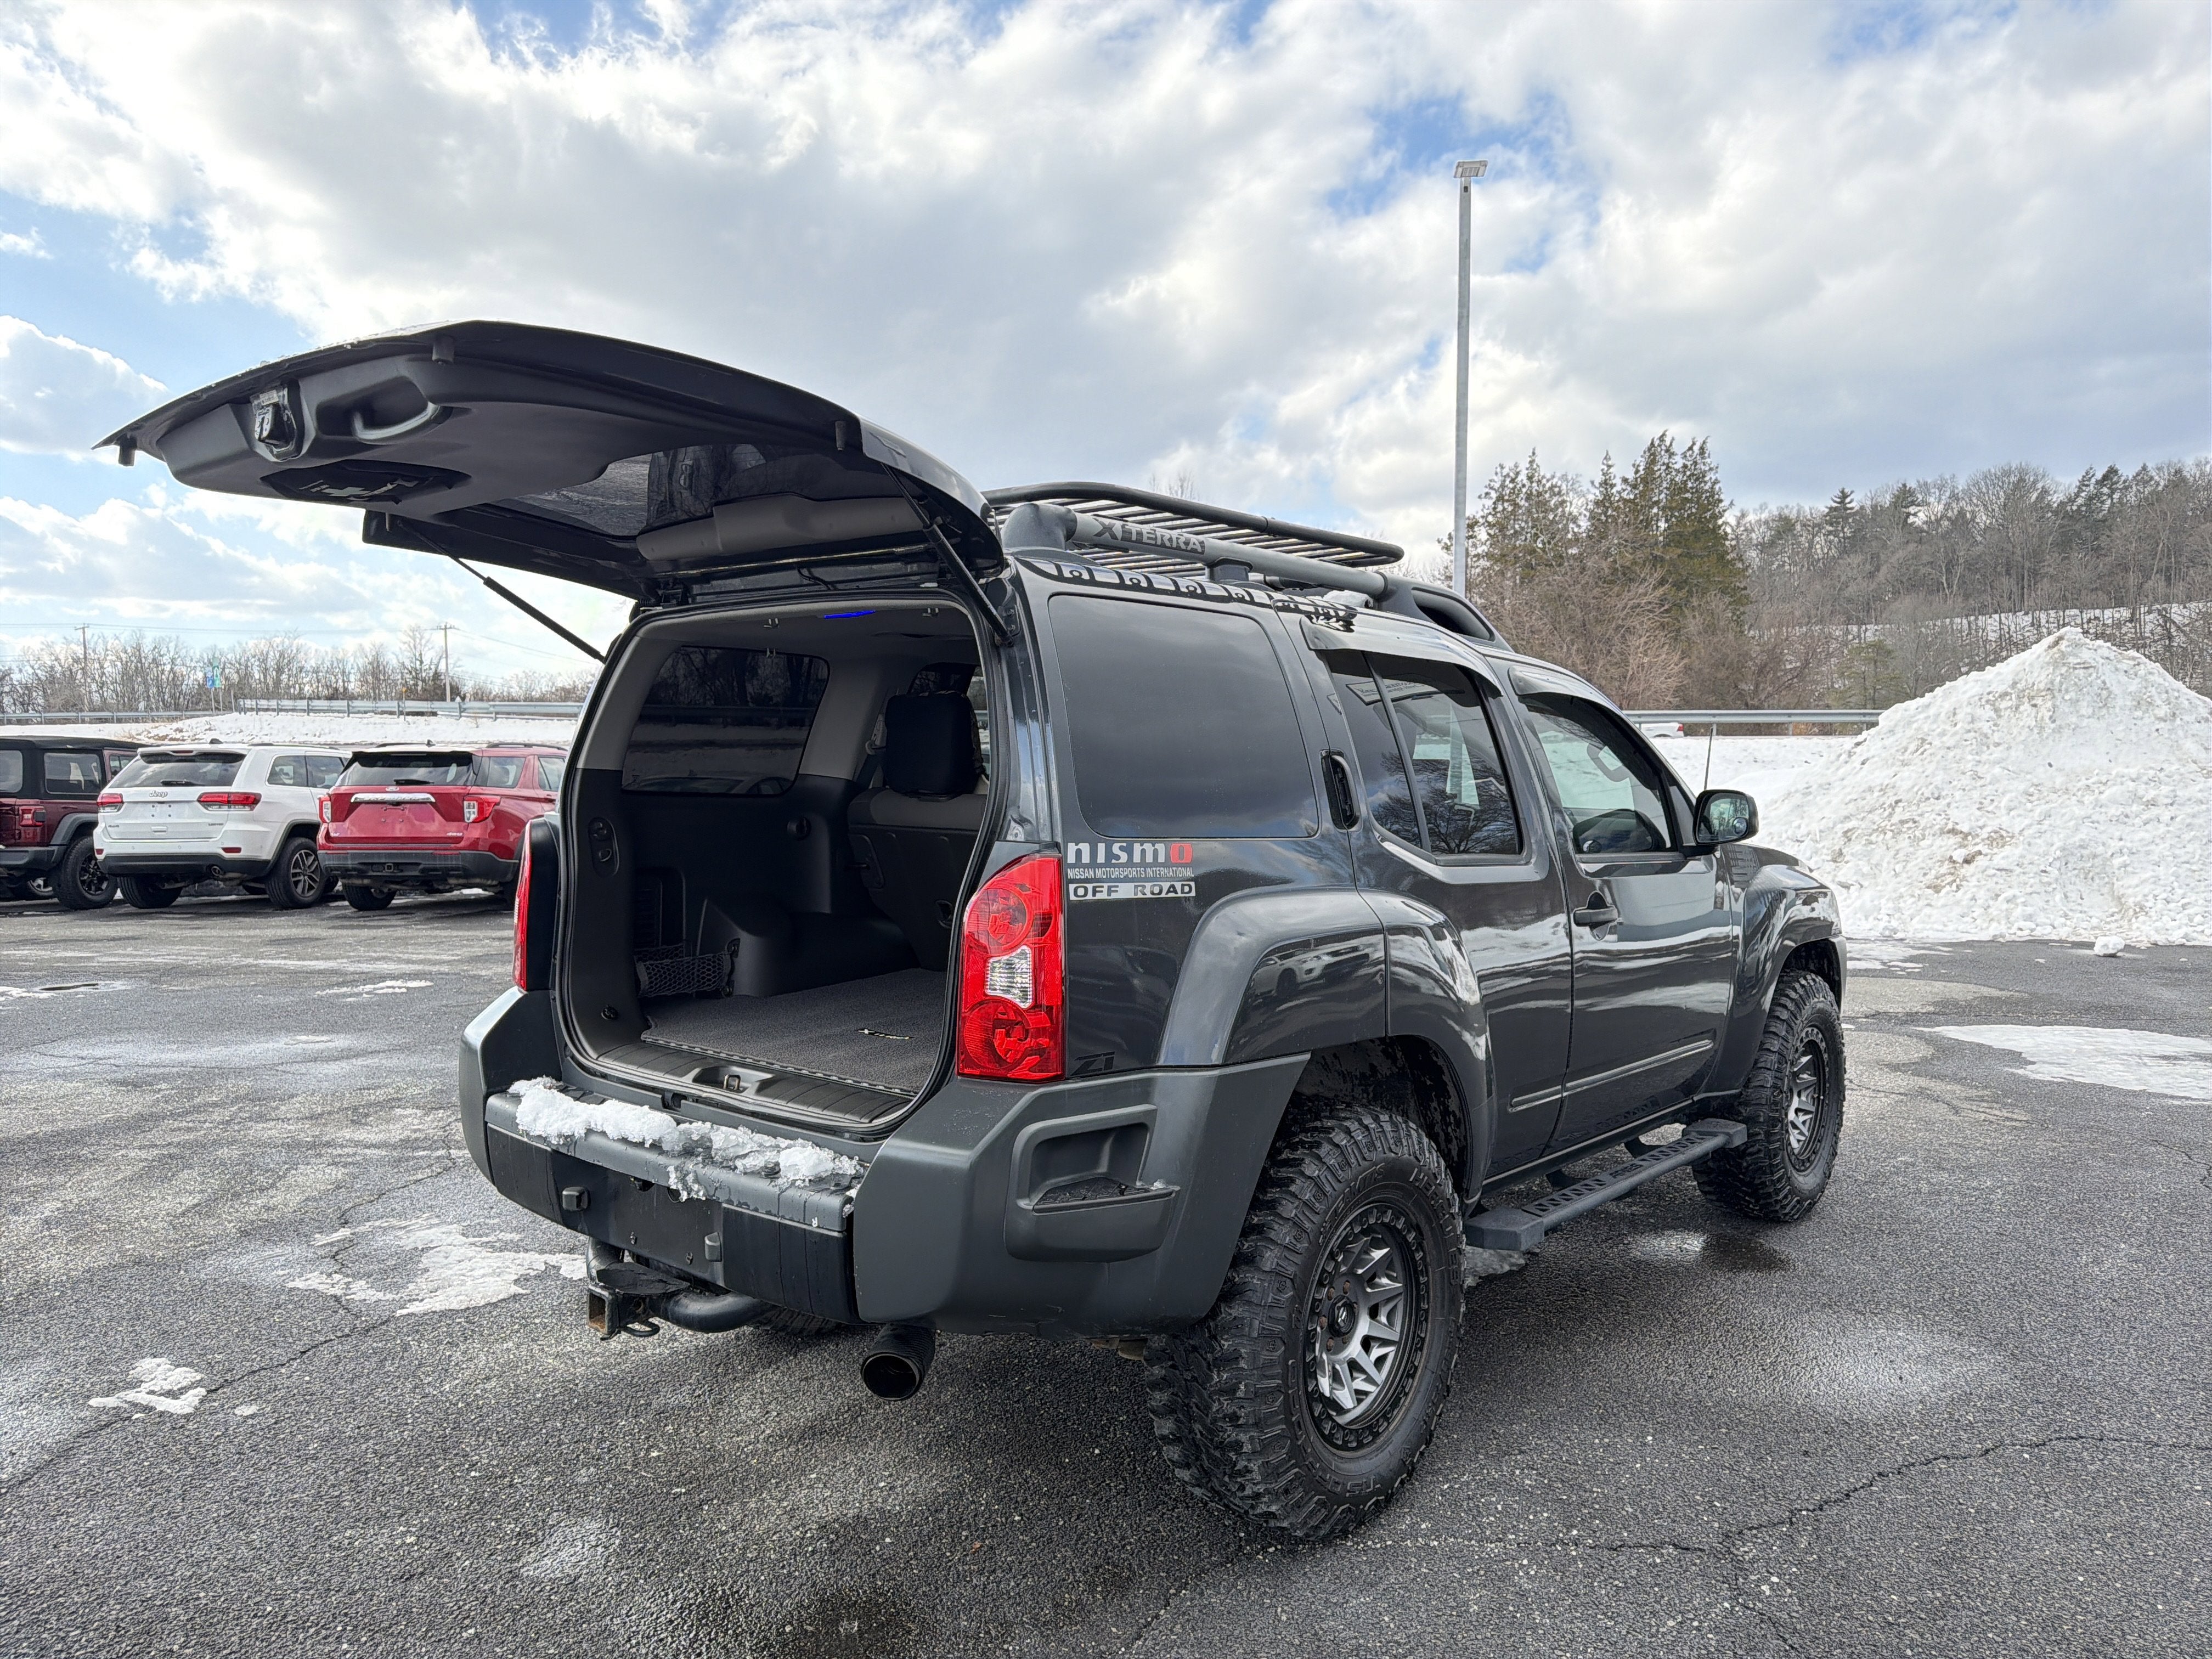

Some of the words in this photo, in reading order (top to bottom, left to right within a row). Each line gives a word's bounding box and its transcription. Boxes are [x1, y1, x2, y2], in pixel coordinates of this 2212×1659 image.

[1093, 517, 1204, 554] XTERRA
[149, 790, 168, 798] Jeep
[1068, 868, 1094, 879] NISSAN
[1096, 867, 1145, 878] MOTORSPORTS
[1146, 866, 1194, 877] INTERNATIONAL
[1073, 885, 1119, 898] OFF
[1133, 883, 1193, 896] ROAD
